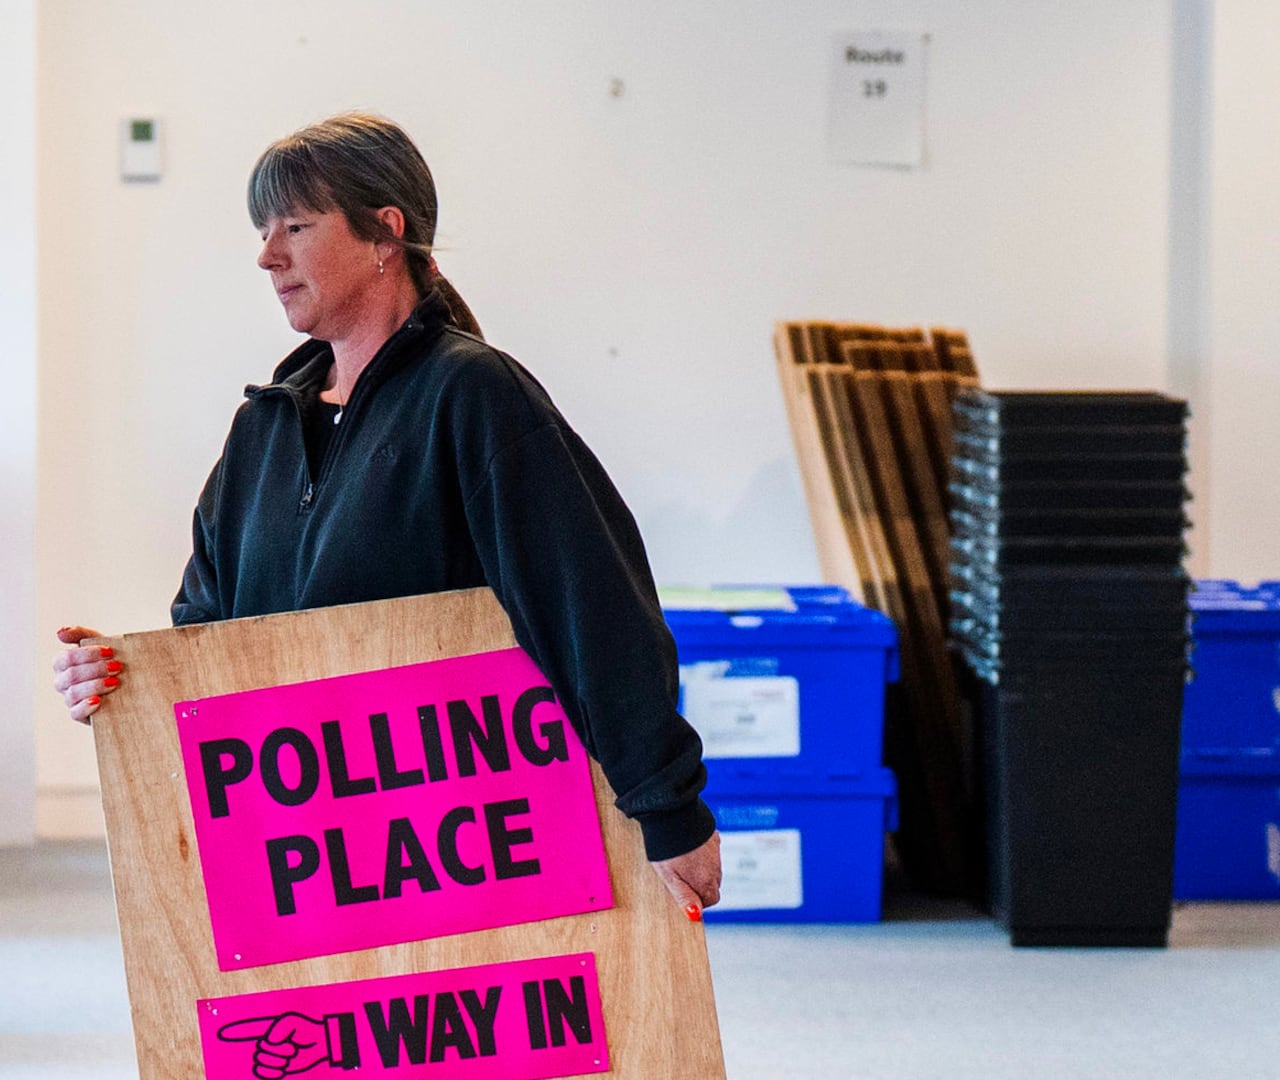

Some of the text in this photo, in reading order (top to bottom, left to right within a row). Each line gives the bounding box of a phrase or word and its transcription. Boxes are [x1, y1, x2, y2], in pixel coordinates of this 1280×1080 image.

[845, 45, 904, 63] Route
[199, 686, 569, 818] POLLING
[265, 797, 541, 917] PLACE
[363, 976, 592, 1068] WAY IN
